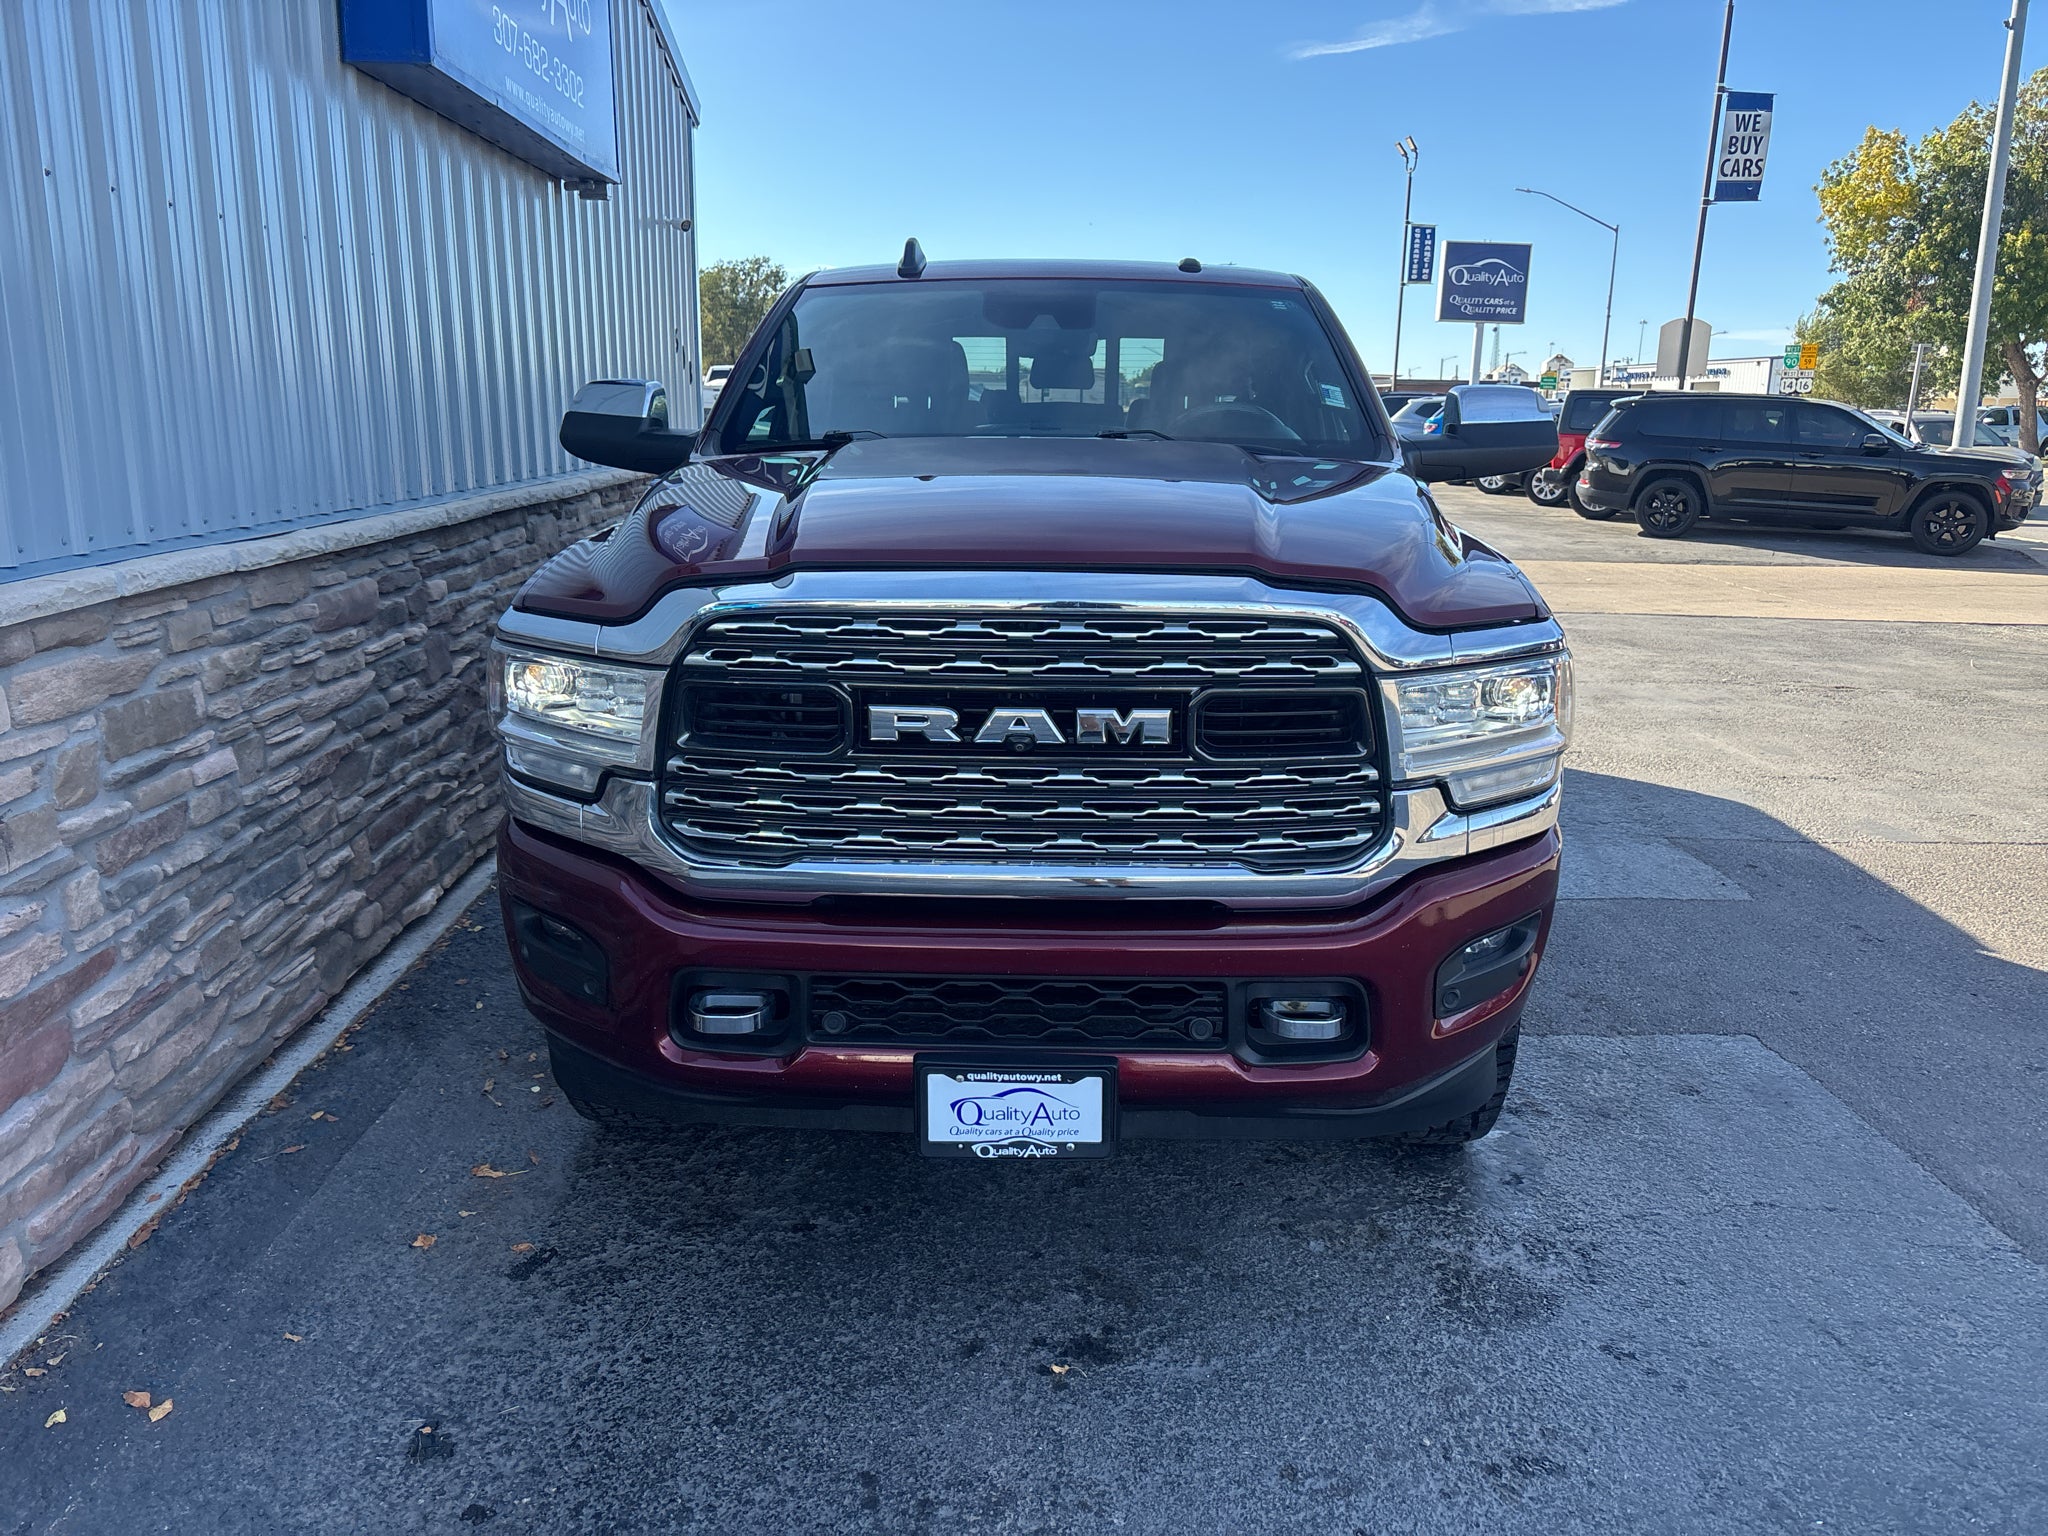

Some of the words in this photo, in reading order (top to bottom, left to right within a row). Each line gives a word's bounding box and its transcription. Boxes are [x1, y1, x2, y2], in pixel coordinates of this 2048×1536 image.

[492, 4, 584, 109] 307-682-3302
[1735, 113, 1762, 132] WE
[1727, 135, 1764, 155] BUY
[1720, 158, 1764, 178] CARS
[1411, 228, 1421, 280] GUARANTEED
[1421, 228, 1432, 280] FINANCING
[1484, 297, 1504, 305] CARS
[1495, 307, 1518, 315] PRICE
[1785, 358, 1797, 366] 90
[1783, 381, 1793, 390] 14
[1800, 381, 1809, 390] 16
[868, 705, 1173, 744] RAM
[967, 1072, 1062, 1083] qualityautowy.net
[956, 1100, 1081, 1127] QualityAuto
[949, 1126, 984, 1136] Quality
[984, 1128, 1003, 1136] cars
[1004, 1128, 1014, 1136] at
[1021, 1126, 1056, 1138] Quality
[1056, 1128, 1080, 1138] price
[976, 1144, 1058, 1159] QualityAuto
